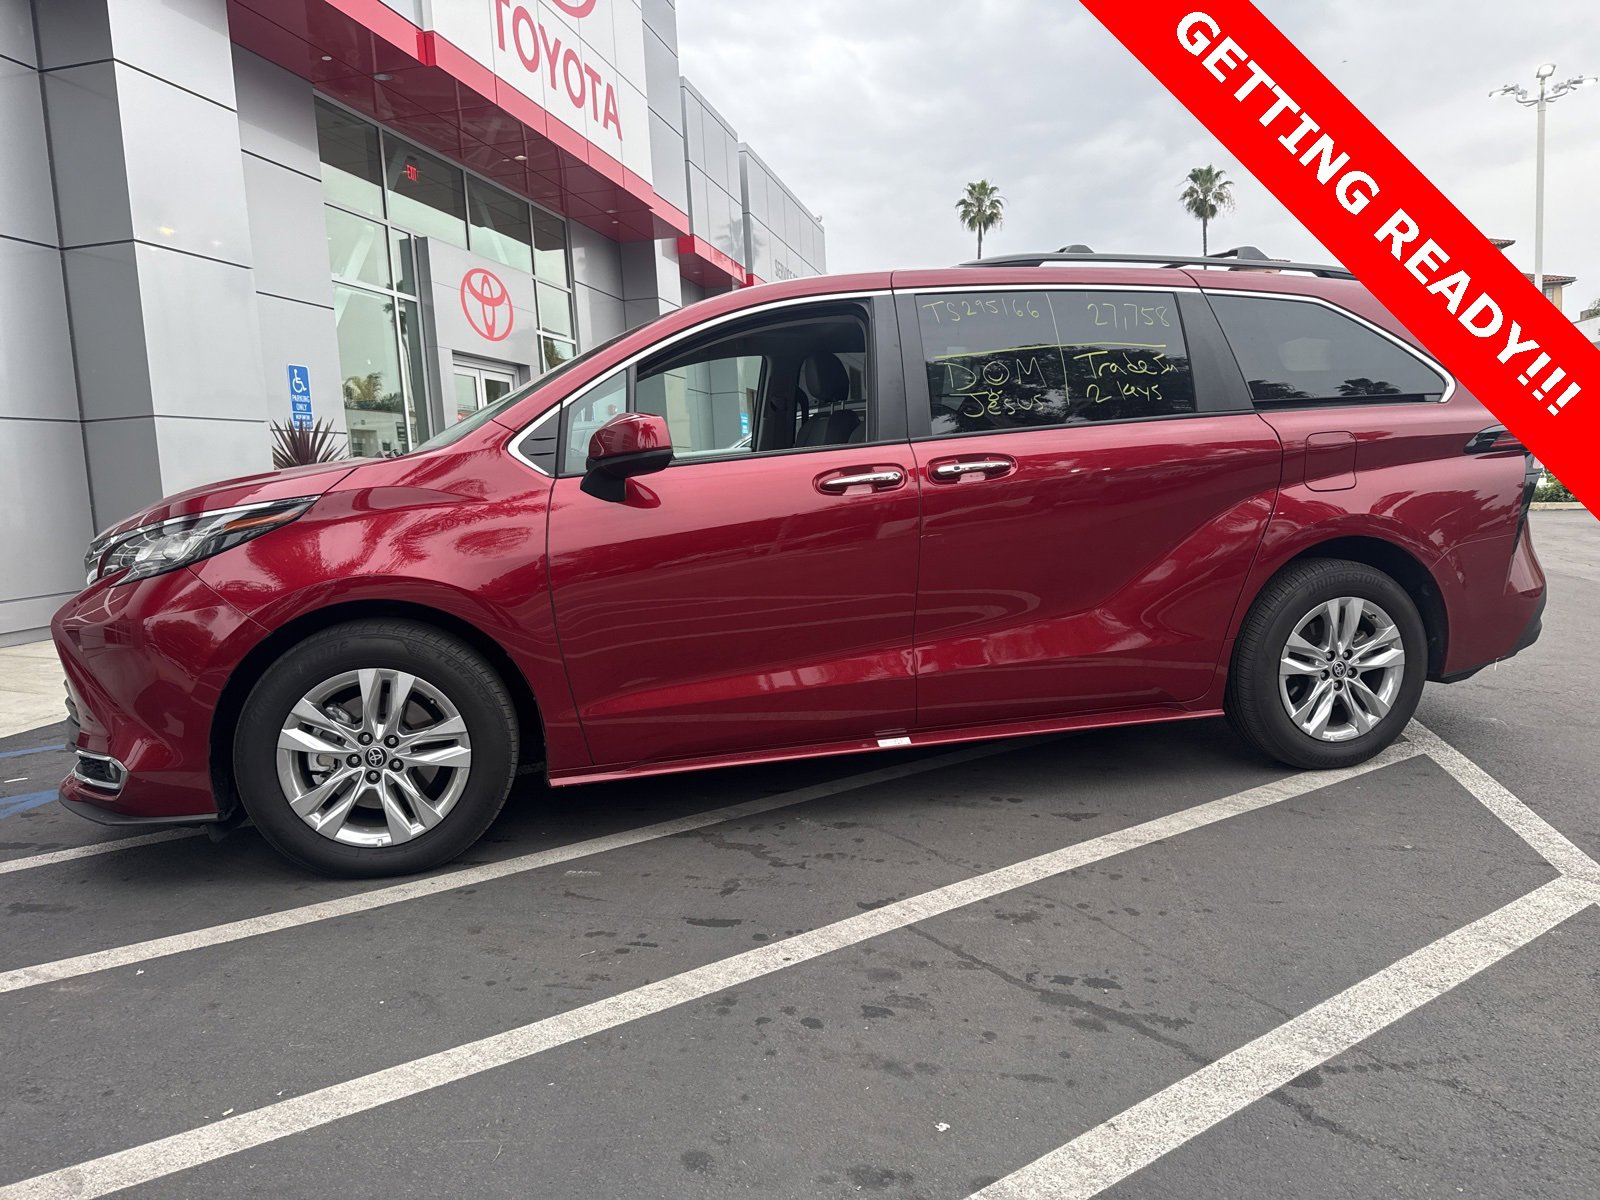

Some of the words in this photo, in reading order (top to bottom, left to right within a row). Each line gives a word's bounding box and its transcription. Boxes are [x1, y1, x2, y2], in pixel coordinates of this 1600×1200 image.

[495, 0, 623, 141] TOYOTA
[406, 164, 418, 181] EXIT
[1087, 303, 1170, 331] 27,758
[1073, 350, 1158, 380] Trade
[291, 394, 310, 403] PARKING
[1086, 384, 1112, 403] 2
[295, 403, 308, 411] ONLY
